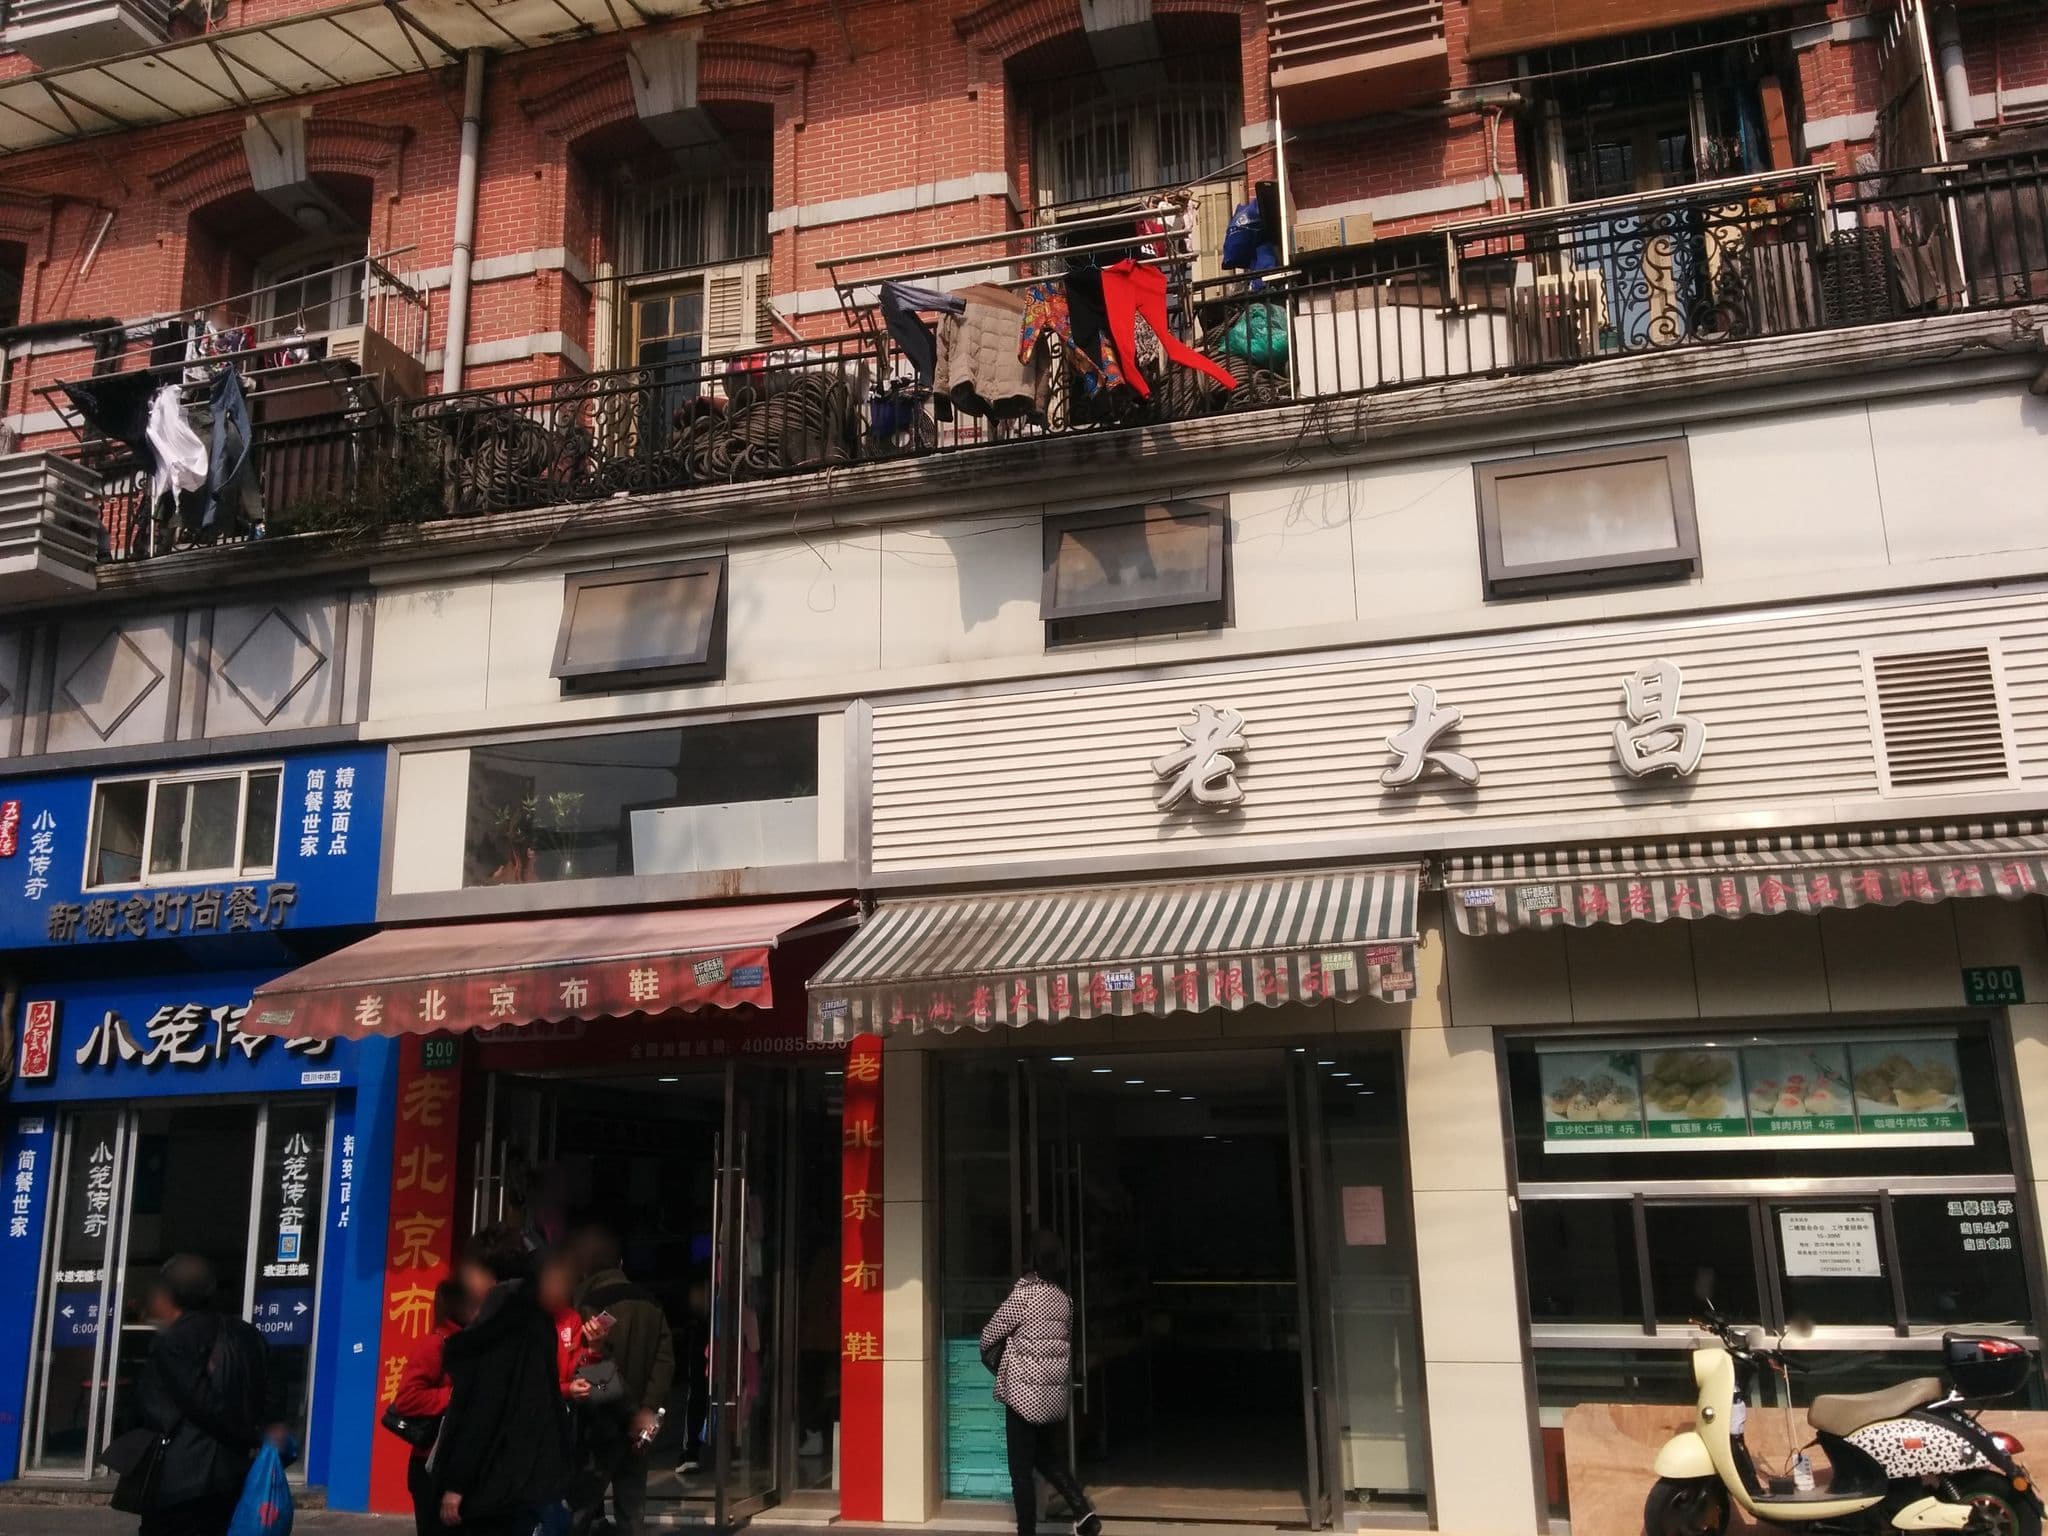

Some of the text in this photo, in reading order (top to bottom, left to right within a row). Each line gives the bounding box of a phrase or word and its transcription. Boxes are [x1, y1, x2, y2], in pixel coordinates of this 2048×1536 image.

[1150, 657, 1707, 812] 老大昌
[299, 768, 326, 857] 简餐世家
[327, 766, 355, 856] 精致面点
[24, 809, 57, 900] 小笼传奇
[48, 882, 297, 945] 新概念时尚餐厅
[1537, 862, 2037, 916] 海老大昌食品有限公司
[354, 967, 661, 1027] 老北京布鞋
[1971, 969, 2014, 990] 500
[303, 1072, 338, 1082] 四川中路店
[426, 1041, 454, 1059] 500
[1619, 1124, 1636, 1135] 4元
[1706, 1122, 1724, 1133] 4元
[1818, 1119, 1836, 1130] 4元
[1934, 1116, 1952, 1128] 7元
[9, 1149, 37, 1238] 简餐世家
[83, 1140, 114, 1238] 小笼传奇
[278, 1132, 311, 1227] 小笼传奇
[842, 1053, 883, 1362] 老北京布鞋
[1947, 1200, 2014, 1216] 温馨提示
[262, 1263, 310, 1277] 欢迎光临
